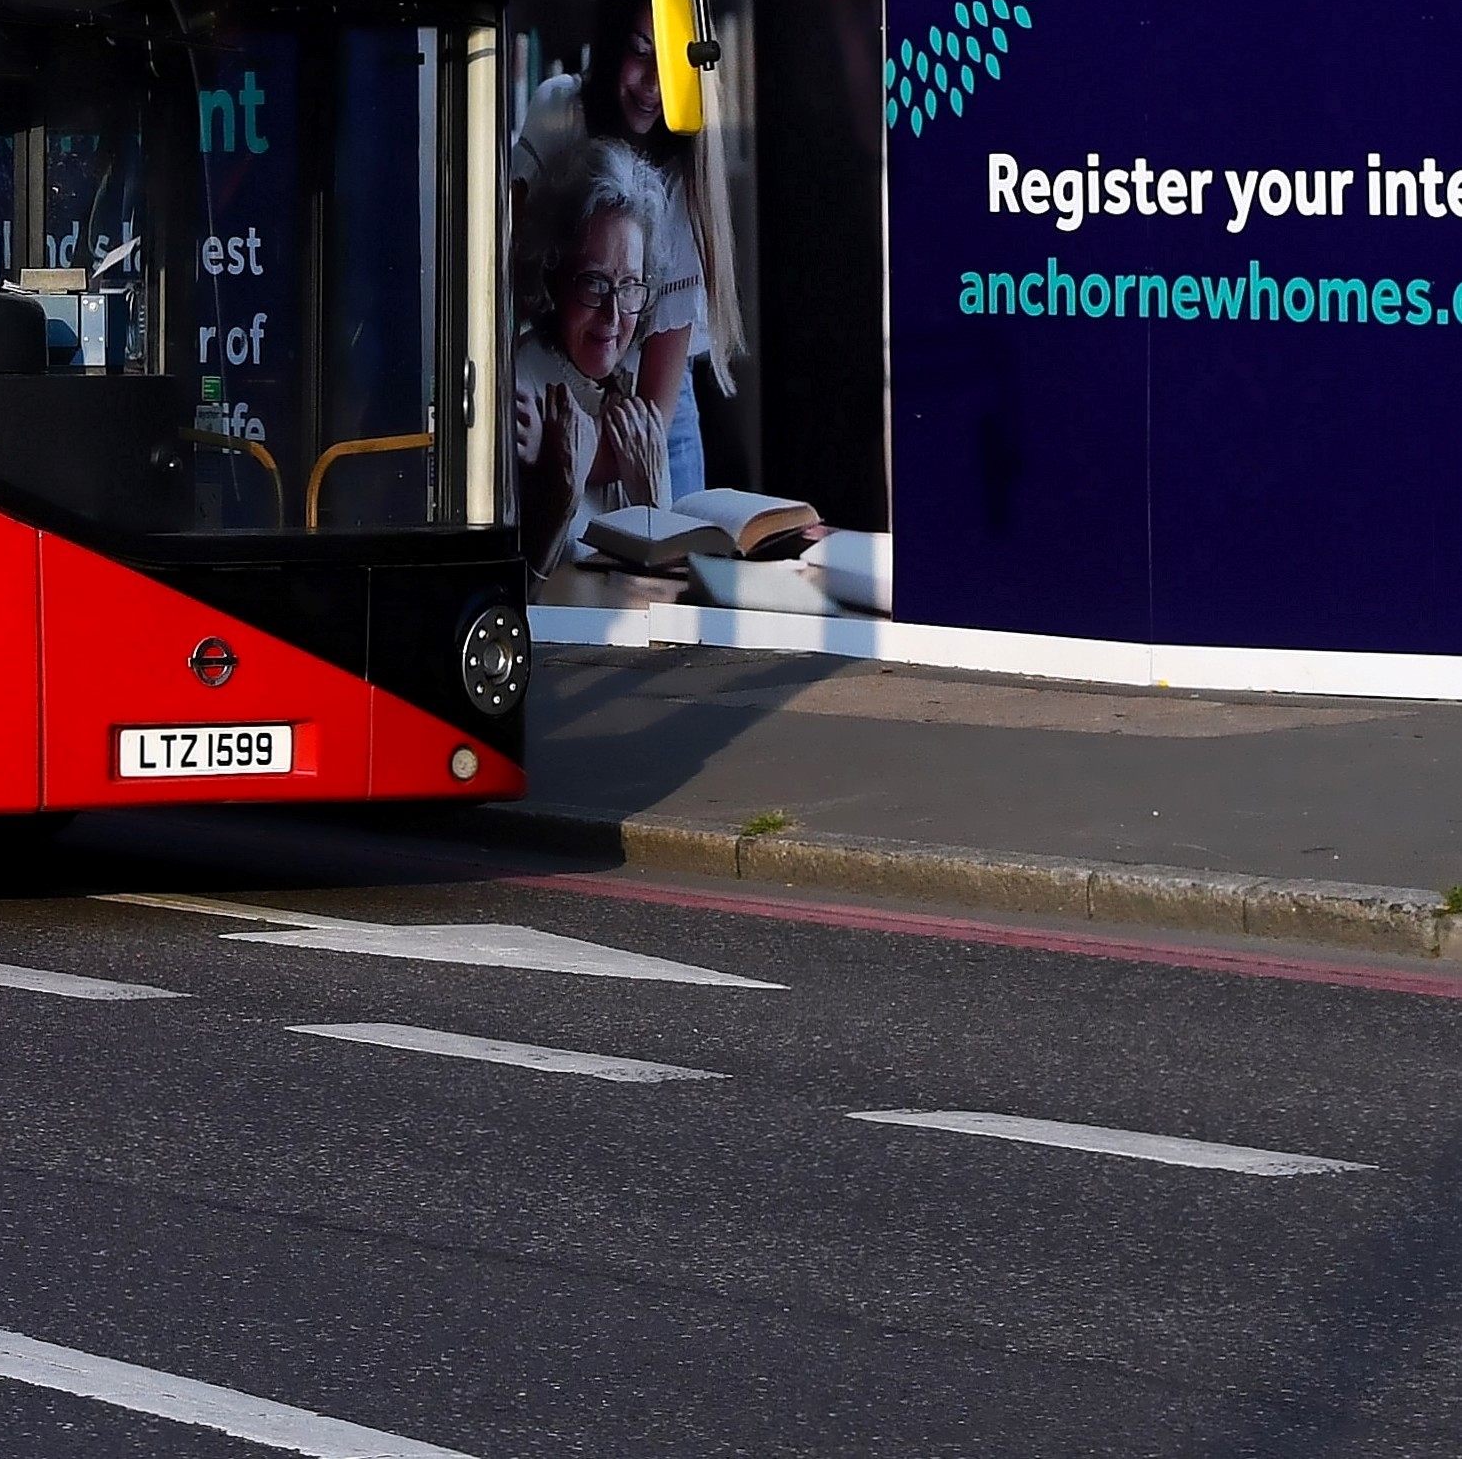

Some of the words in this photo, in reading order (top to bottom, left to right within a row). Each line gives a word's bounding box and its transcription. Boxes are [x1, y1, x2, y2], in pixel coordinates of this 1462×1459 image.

[988, 152, 1213, 232] Register
[1225, 169, 1354, 234] your
[226, 312, 268, 366] of
[139, 734, 198, 769] LTZ
[208, 732, 274, 768] 1599
